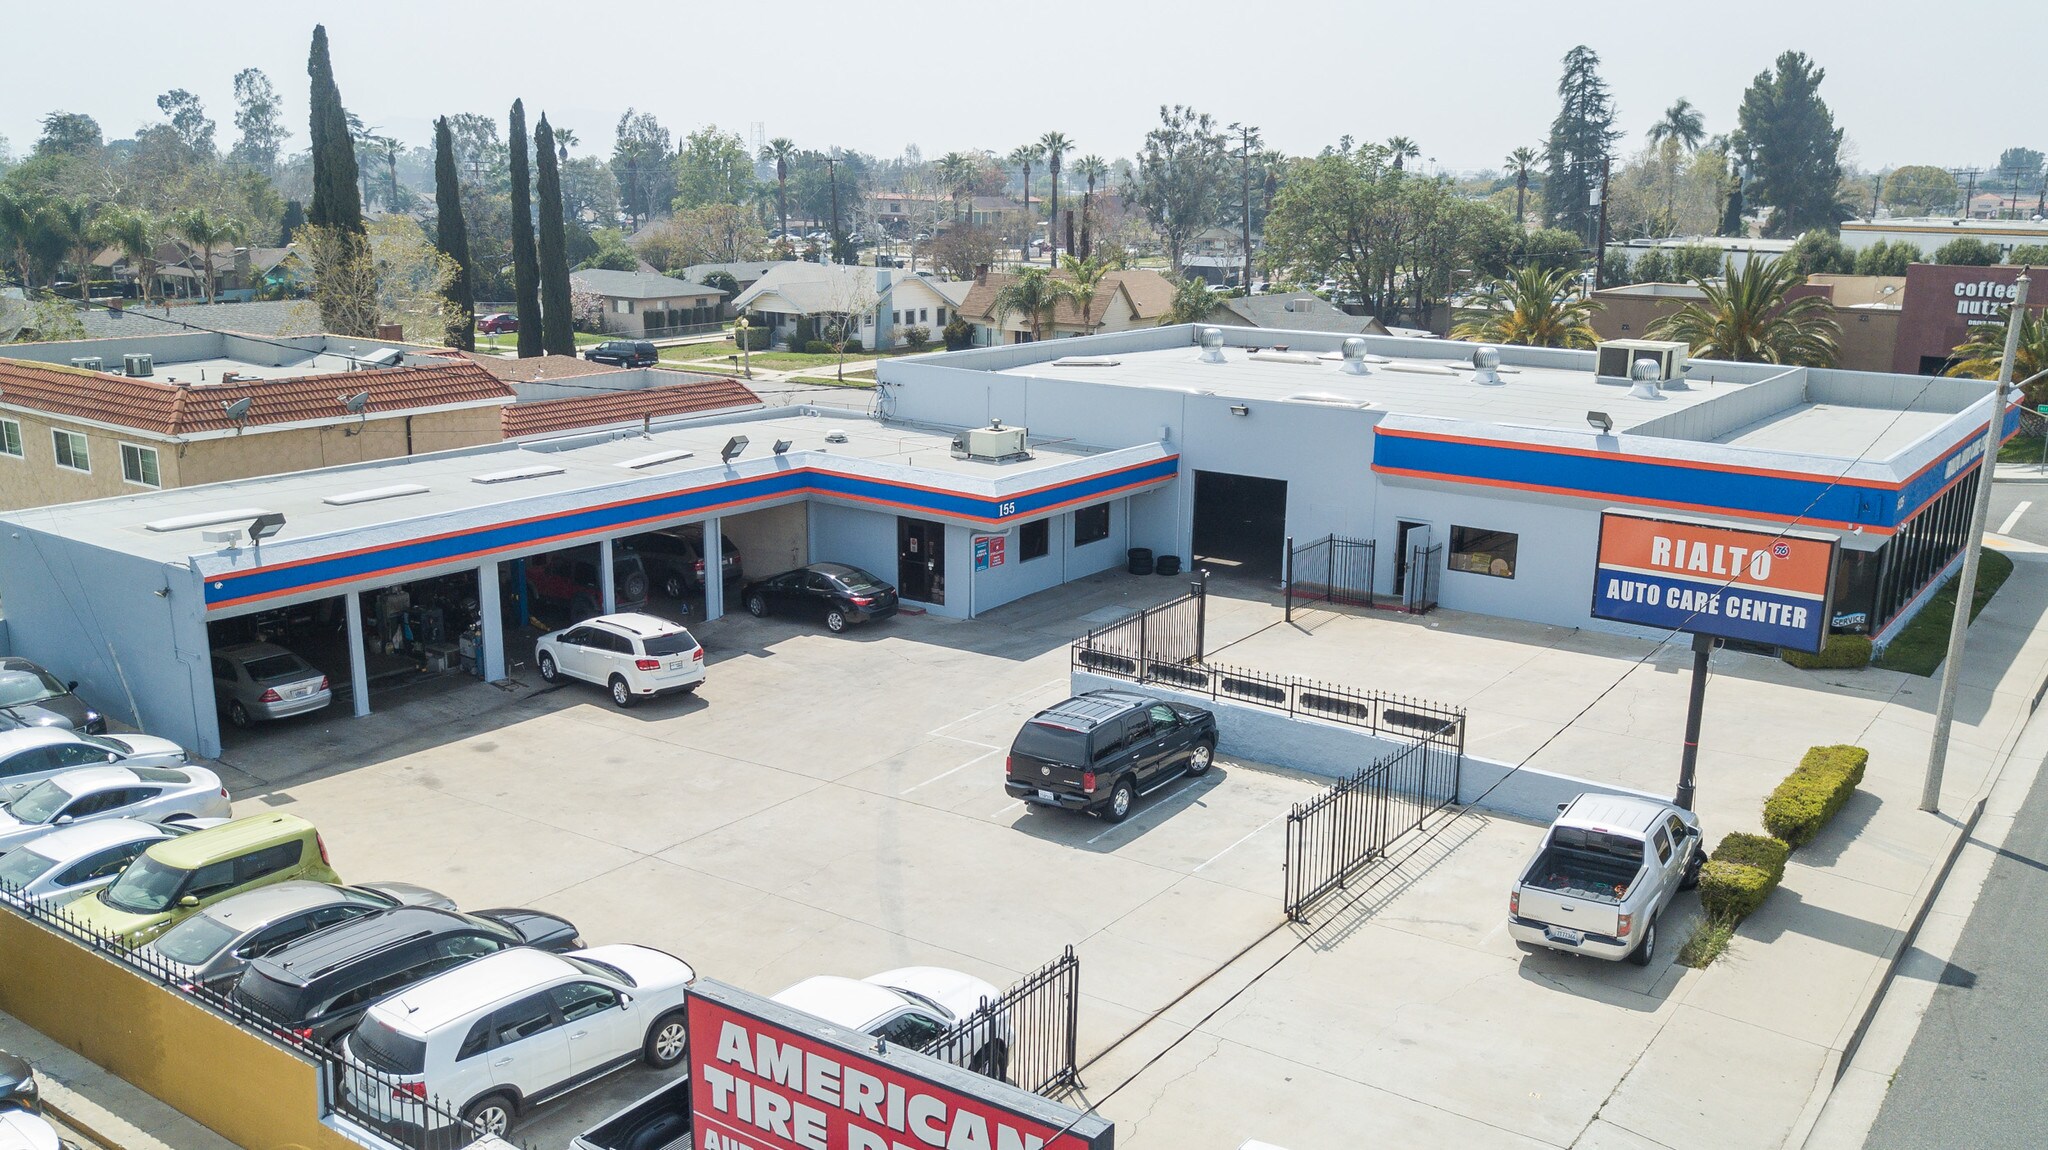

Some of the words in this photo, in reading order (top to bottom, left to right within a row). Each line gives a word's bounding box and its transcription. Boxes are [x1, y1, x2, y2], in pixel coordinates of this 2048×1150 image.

[1954, 281, 2018, 299] coffee
[999, 502, 1015, 517] 155
[1651, 536, 1771, 581] RIALTO
[1606, 578, 1660, 606] AUTO
[1666, 587, 1720, 615] CARE
[1726, 596, 1808, 629] CENTER
[1833, 615, 1865, 626] SERVICE
[703, 1064, 827, 1150] TIRE
